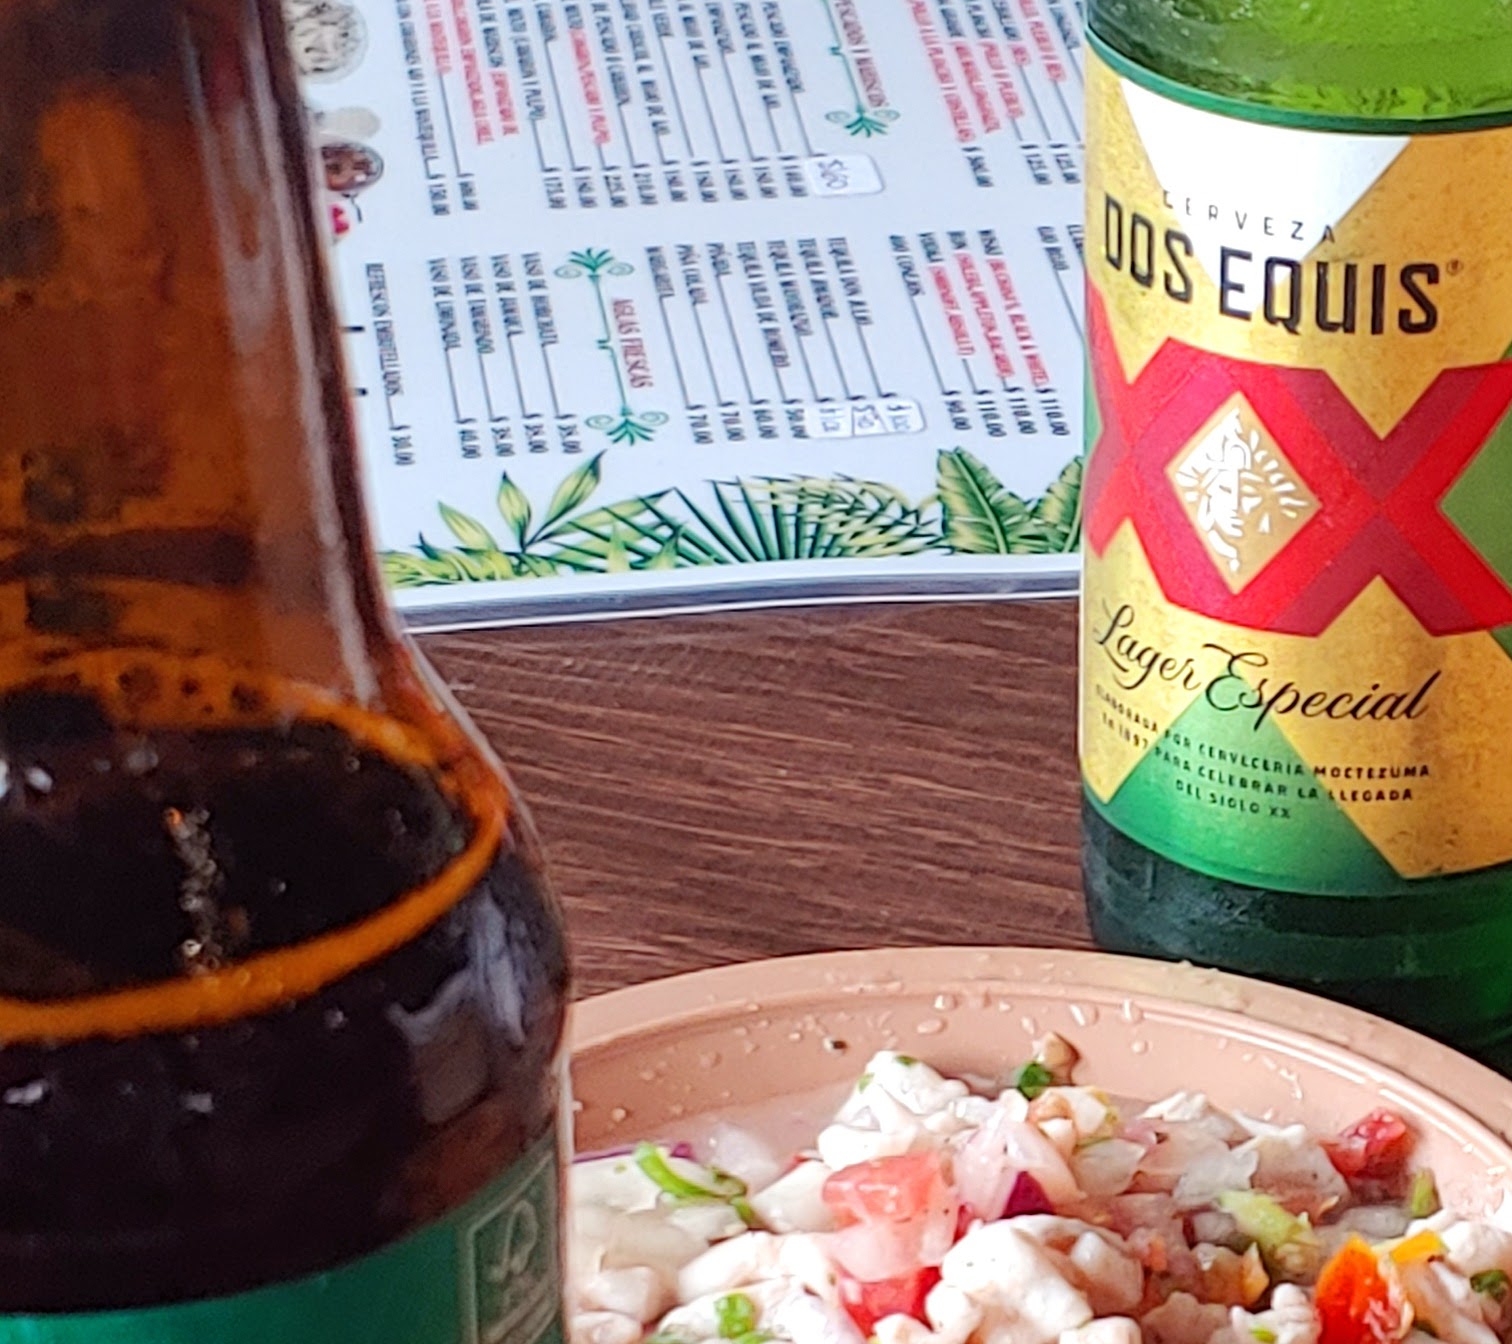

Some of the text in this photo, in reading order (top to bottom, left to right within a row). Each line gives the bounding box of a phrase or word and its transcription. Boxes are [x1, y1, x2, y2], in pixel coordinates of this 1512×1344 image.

[1163, 189, 1336, 244] CERVEZA
[1104, 191, 1193, 303] DOS
[1219, 245, 1440, 335] EQUIS
[1094, 602, 1443, 732] Lager Especial
[1198, 763, 1289, 798] CELEBRAR
[1296, 785, 1320, 801] LA
[1313, 764, 1430, 779] MOCTEZUMA
[1175, 779, 1202, 801] DEL
[1269, 806, 1292, 819] XX
